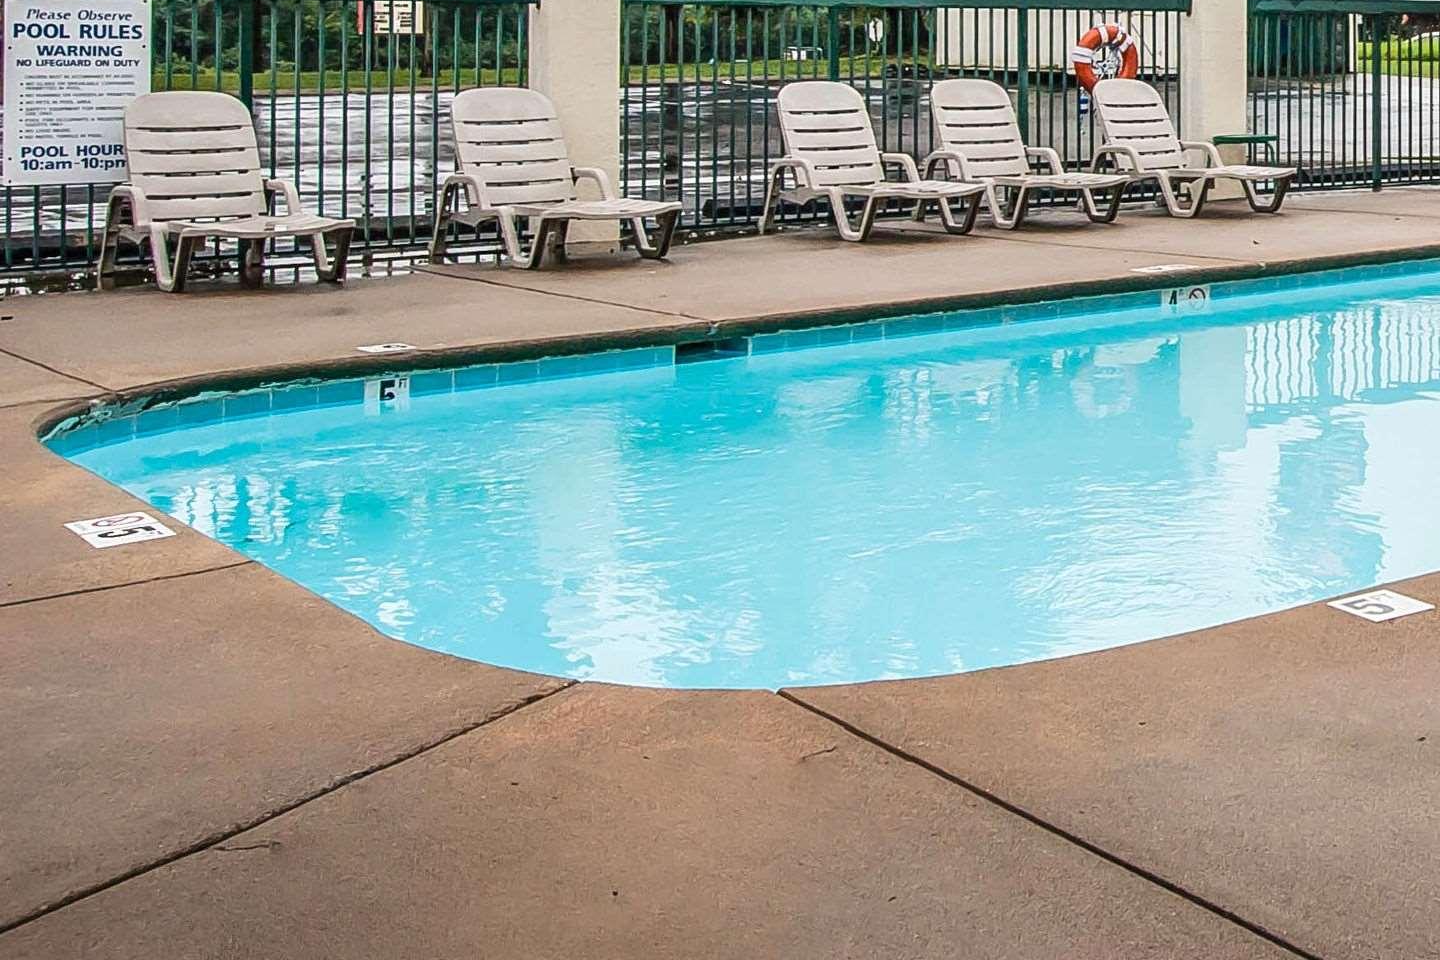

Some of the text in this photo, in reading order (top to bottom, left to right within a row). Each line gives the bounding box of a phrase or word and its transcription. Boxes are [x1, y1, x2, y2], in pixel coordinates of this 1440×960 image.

[26, 8, 132, 21] Please Observe
[13, 23, 143, 39] POOL RULES
[36, 45, 123, 57] WARNING
[16, 59, 140, 67] NO LIFEGUARD ON DUTY
[21, 144, 124, 158] POOL HOUR
[380, 379, 396, 402] 5
[98, 525, 156, 538] 5
[1342, 598, 1395, 615] 5
